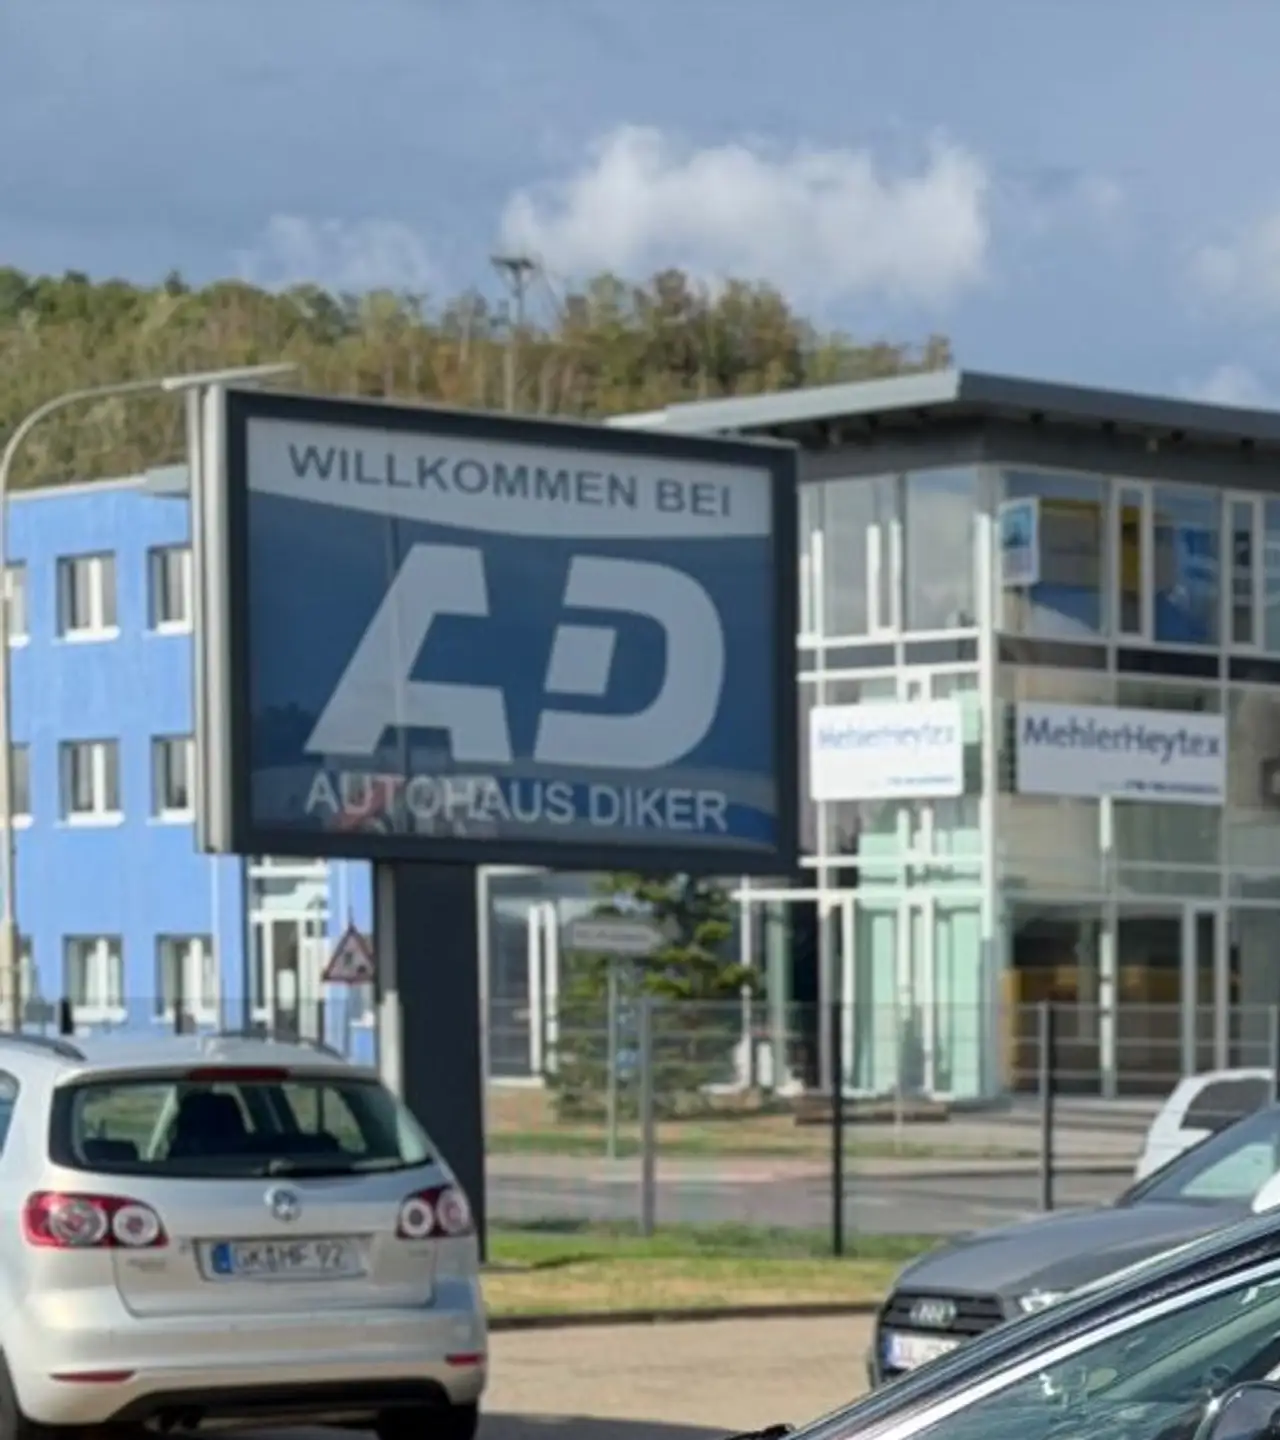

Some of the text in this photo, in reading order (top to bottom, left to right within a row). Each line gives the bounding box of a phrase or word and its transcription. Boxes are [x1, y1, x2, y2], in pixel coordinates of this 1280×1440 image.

[287, 443, 732, 517] WILLKOMMEN BEI
[303, 543, 726, 769] AD
[1022, 714, 1220, 765] MehlerHeytex
[304, 769, 729, 832] AUTOHAUS DIKER
